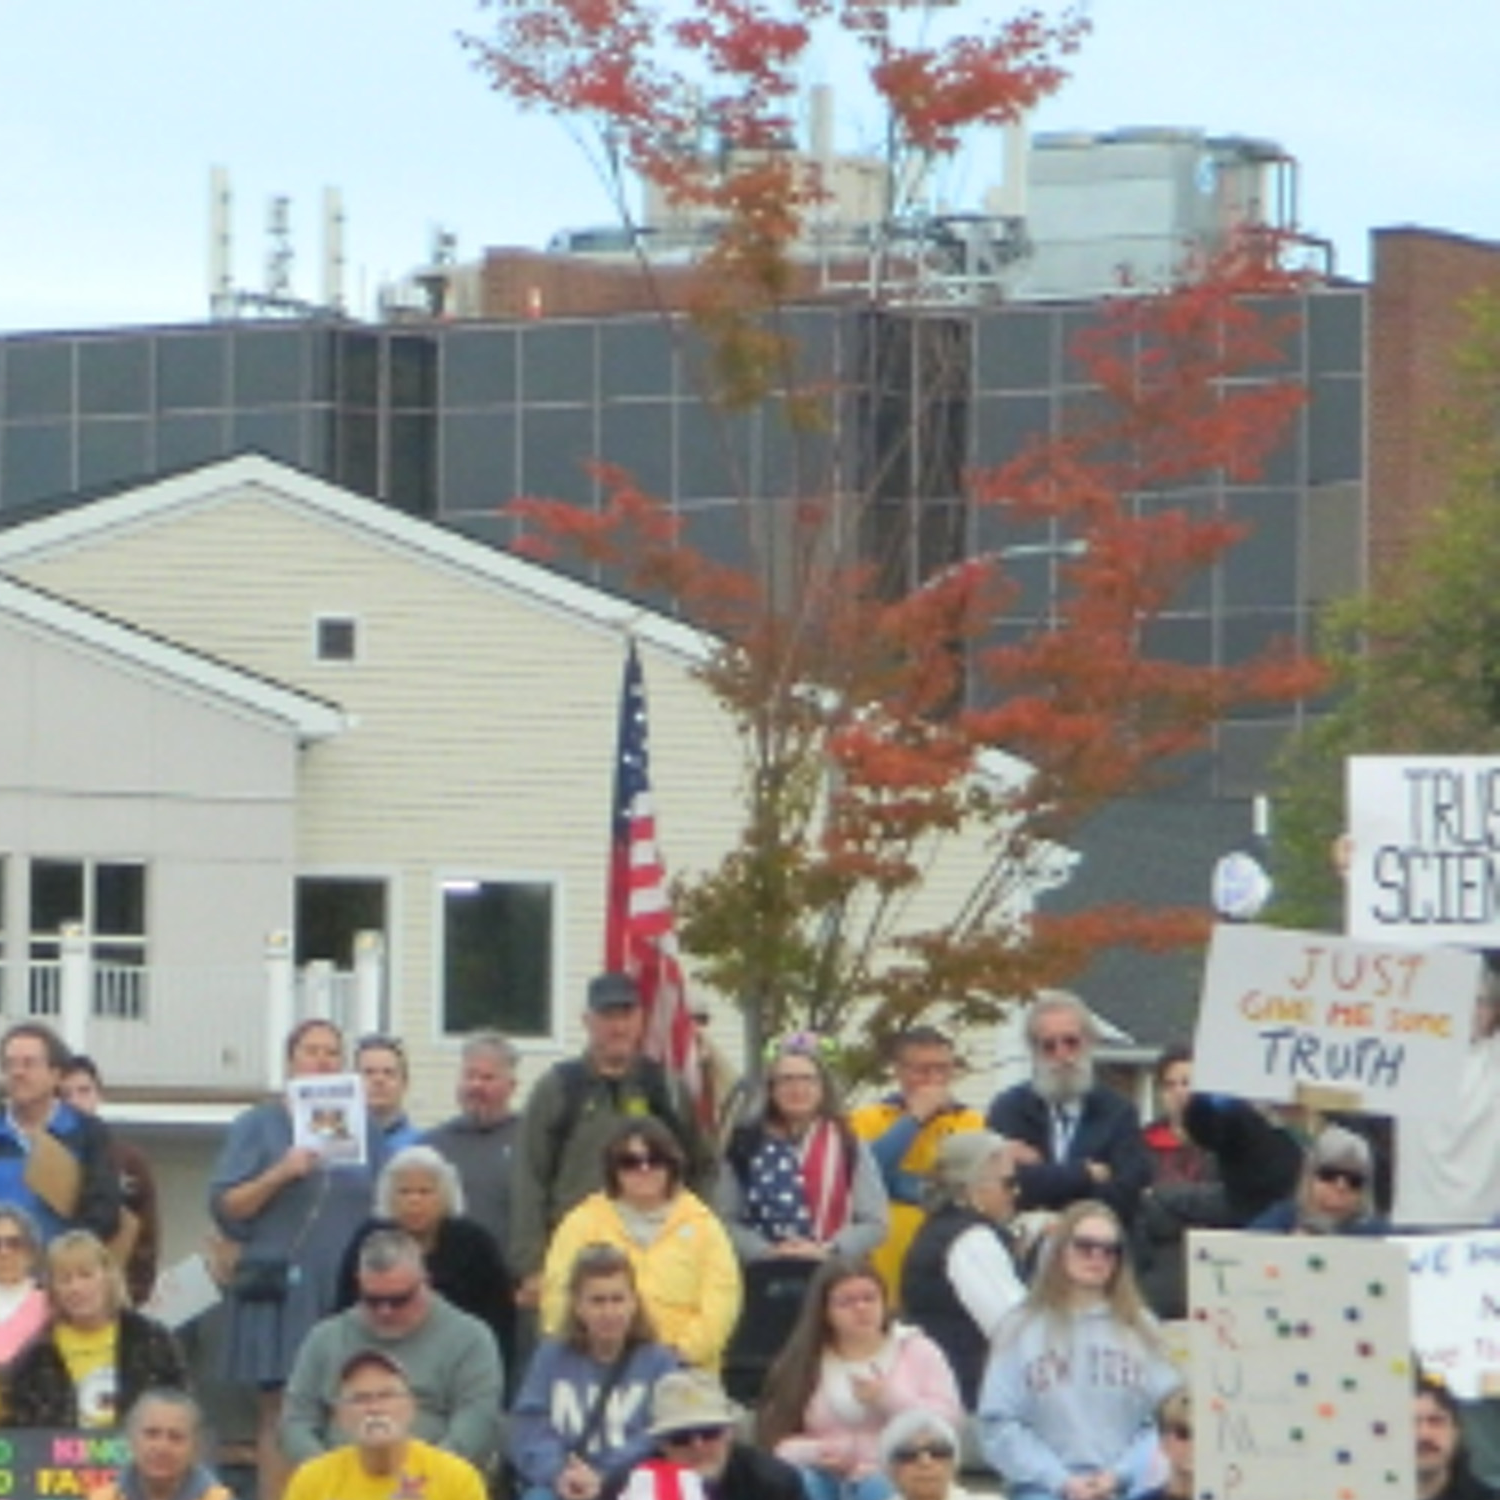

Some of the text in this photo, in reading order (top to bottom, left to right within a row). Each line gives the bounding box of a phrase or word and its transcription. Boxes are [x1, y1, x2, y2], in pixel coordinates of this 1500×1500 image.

[1289, 947, 1425, 997] JUST
[1326, 1001, 1375, 1027] ME
[1258, 1026, 1405, 1087] TRUTH
[53, 1437, 133, 1466] KING
